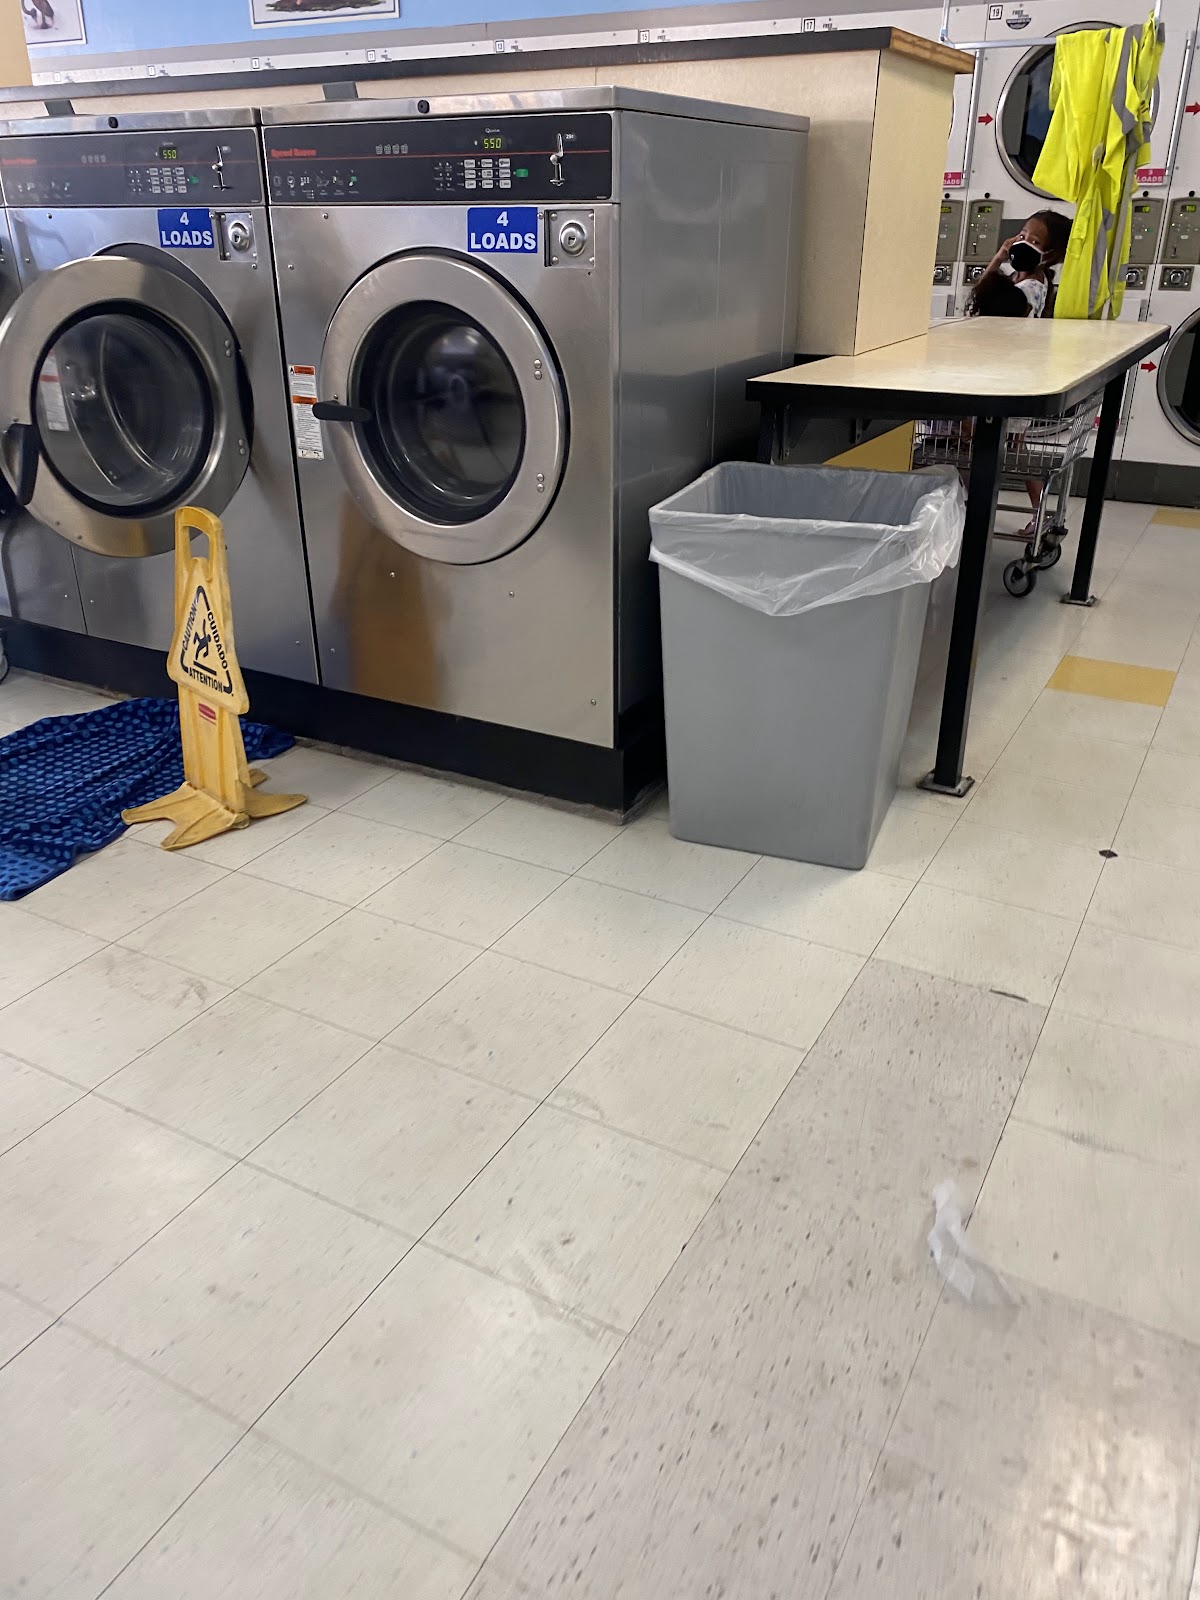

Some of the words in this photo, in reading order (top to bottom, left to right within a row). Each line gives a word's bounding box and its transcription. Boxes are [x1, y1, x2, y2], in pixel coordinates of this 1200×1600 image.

[992, 8, 1000, 17] 19
[806, 21, 813, 29] 17
[483, 137, 502, 149] 550
[162, 149, 177, 159] 550
[179, 211, 190, 226] 4
[496, 210, 509, 227] 4
[161, 230, 213, 246] LOADS
[470, 232, 537, 250] LOADS
[182, 605, 198, 651] CAUTION
[207, 611, 229, 670] CUIDADO
[188, 666, 223, 694] ATTENTION
